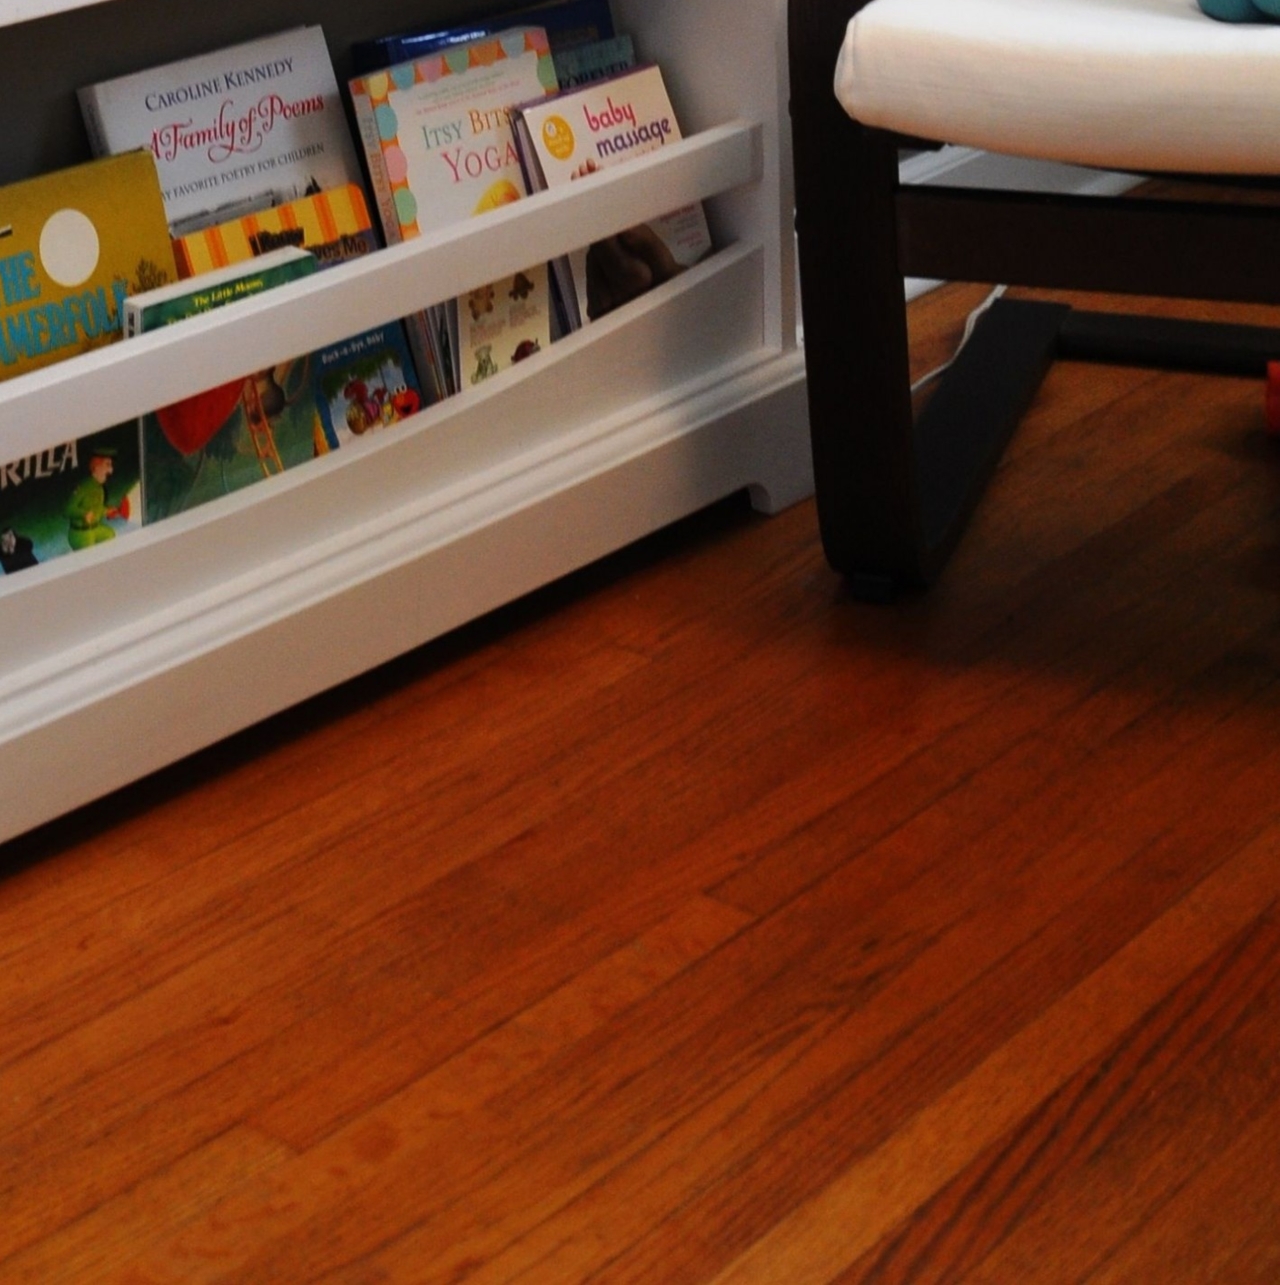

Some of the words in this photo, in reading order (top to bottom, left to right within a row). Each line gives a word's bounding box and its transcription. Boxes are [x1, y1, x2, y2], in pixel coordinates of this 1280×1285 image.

[145, 80, 221, 113] CAROLINE
[223, 57, 294, 92] KENNEDY
[159, 98, 236, 163] Family
[239, 106, 257, 145] of
[257, 92, 325, 132] Poems
[422, 120, 463, 150] ITSY
[583, 97, 637, 132] baby
[596, 116, 672, 159] massage
[169, 176, 220, 198] FAVORITE
[221, 164, 257, 184] POETRY
[258, 158, 277, 173] FOR
[278, 141, 326, 166] CHILDREN
[441, 142, 519, 184] YOGA
[193, 294, 210, 308] The
[211, 286, 234, 303] Little
